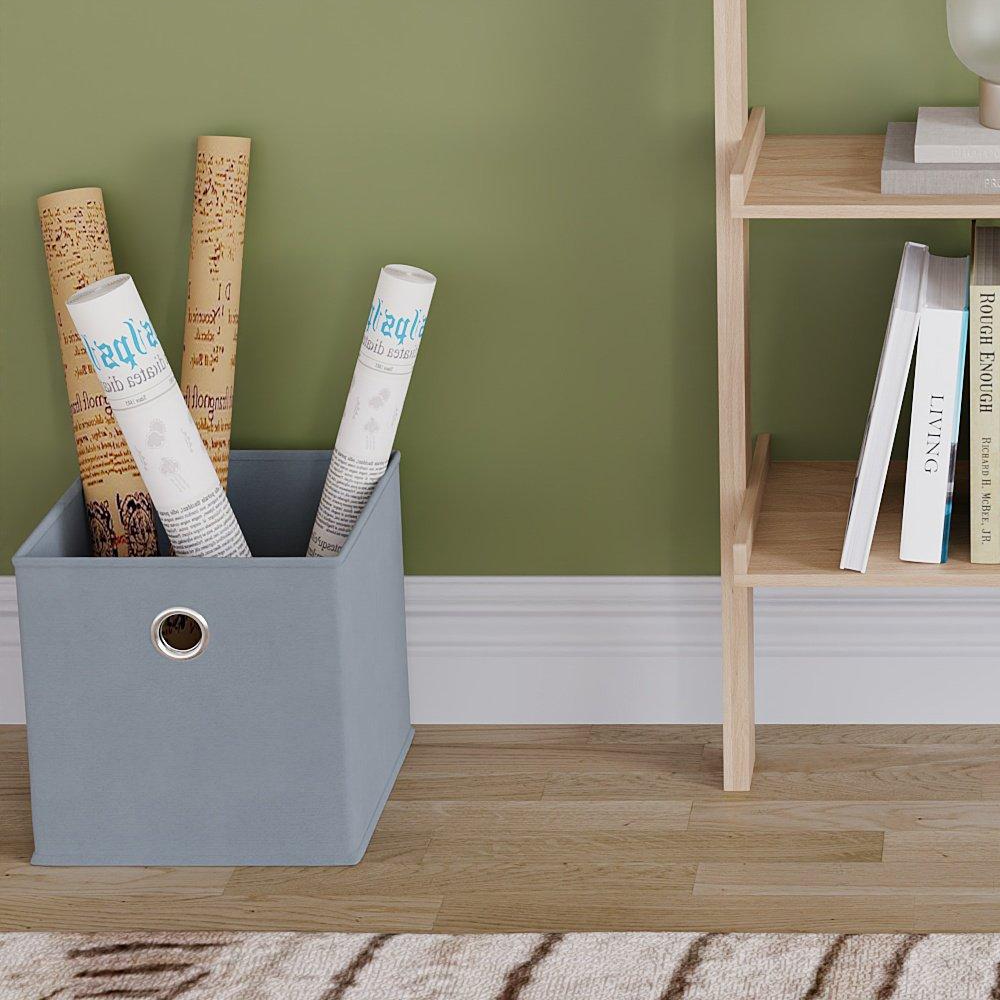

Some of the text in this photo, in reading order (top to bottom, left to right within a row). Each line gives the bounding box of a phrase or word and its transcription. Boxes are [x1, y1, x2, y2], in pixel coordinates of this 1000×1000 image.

[979, 292, 996, 413] ROUGH ENOUGH
[925, 395, 945, 474] LIVING
[981, 436, 992, 476] RICHARD
[981, 478, 991, 489] H.
[980, 528, 991, 545] JR.
